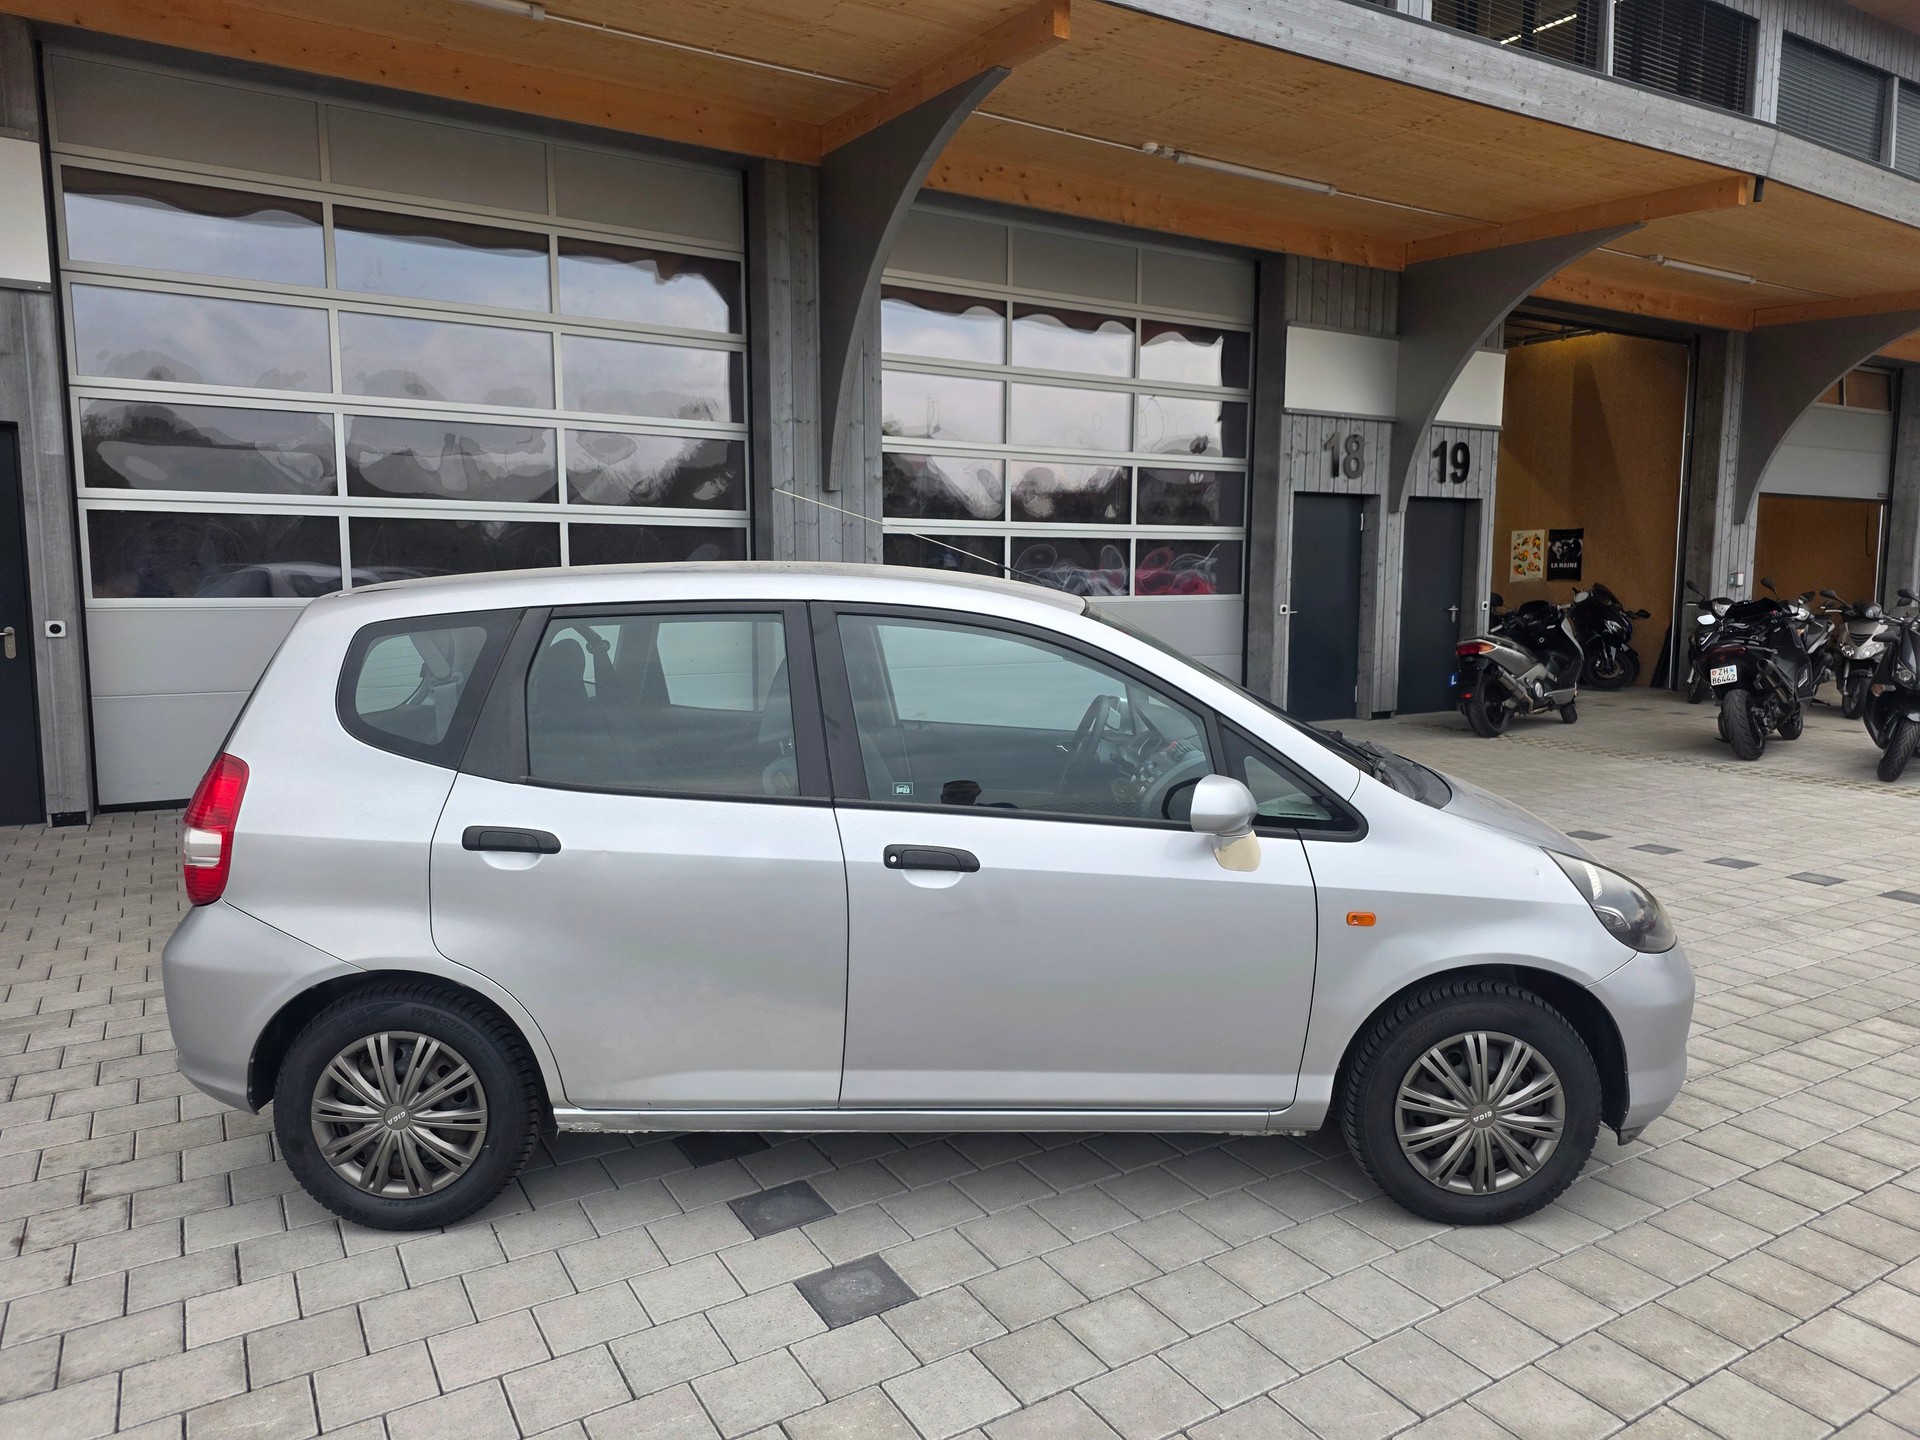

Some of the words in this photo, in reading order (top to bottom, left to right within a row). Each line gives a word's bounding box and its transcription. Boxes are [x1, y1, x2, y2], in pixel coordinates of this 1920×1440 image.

[1323, 431, 1365, 479] 18
[1432, 440, 1471, 484] 19
[1718, 667, 1729, 676] ZH
[1712, 674, 1736, 685] 86442
[387, 1111, 406, 1125] GIGA
[1472, 1110, 1492, 1123] GIGA
